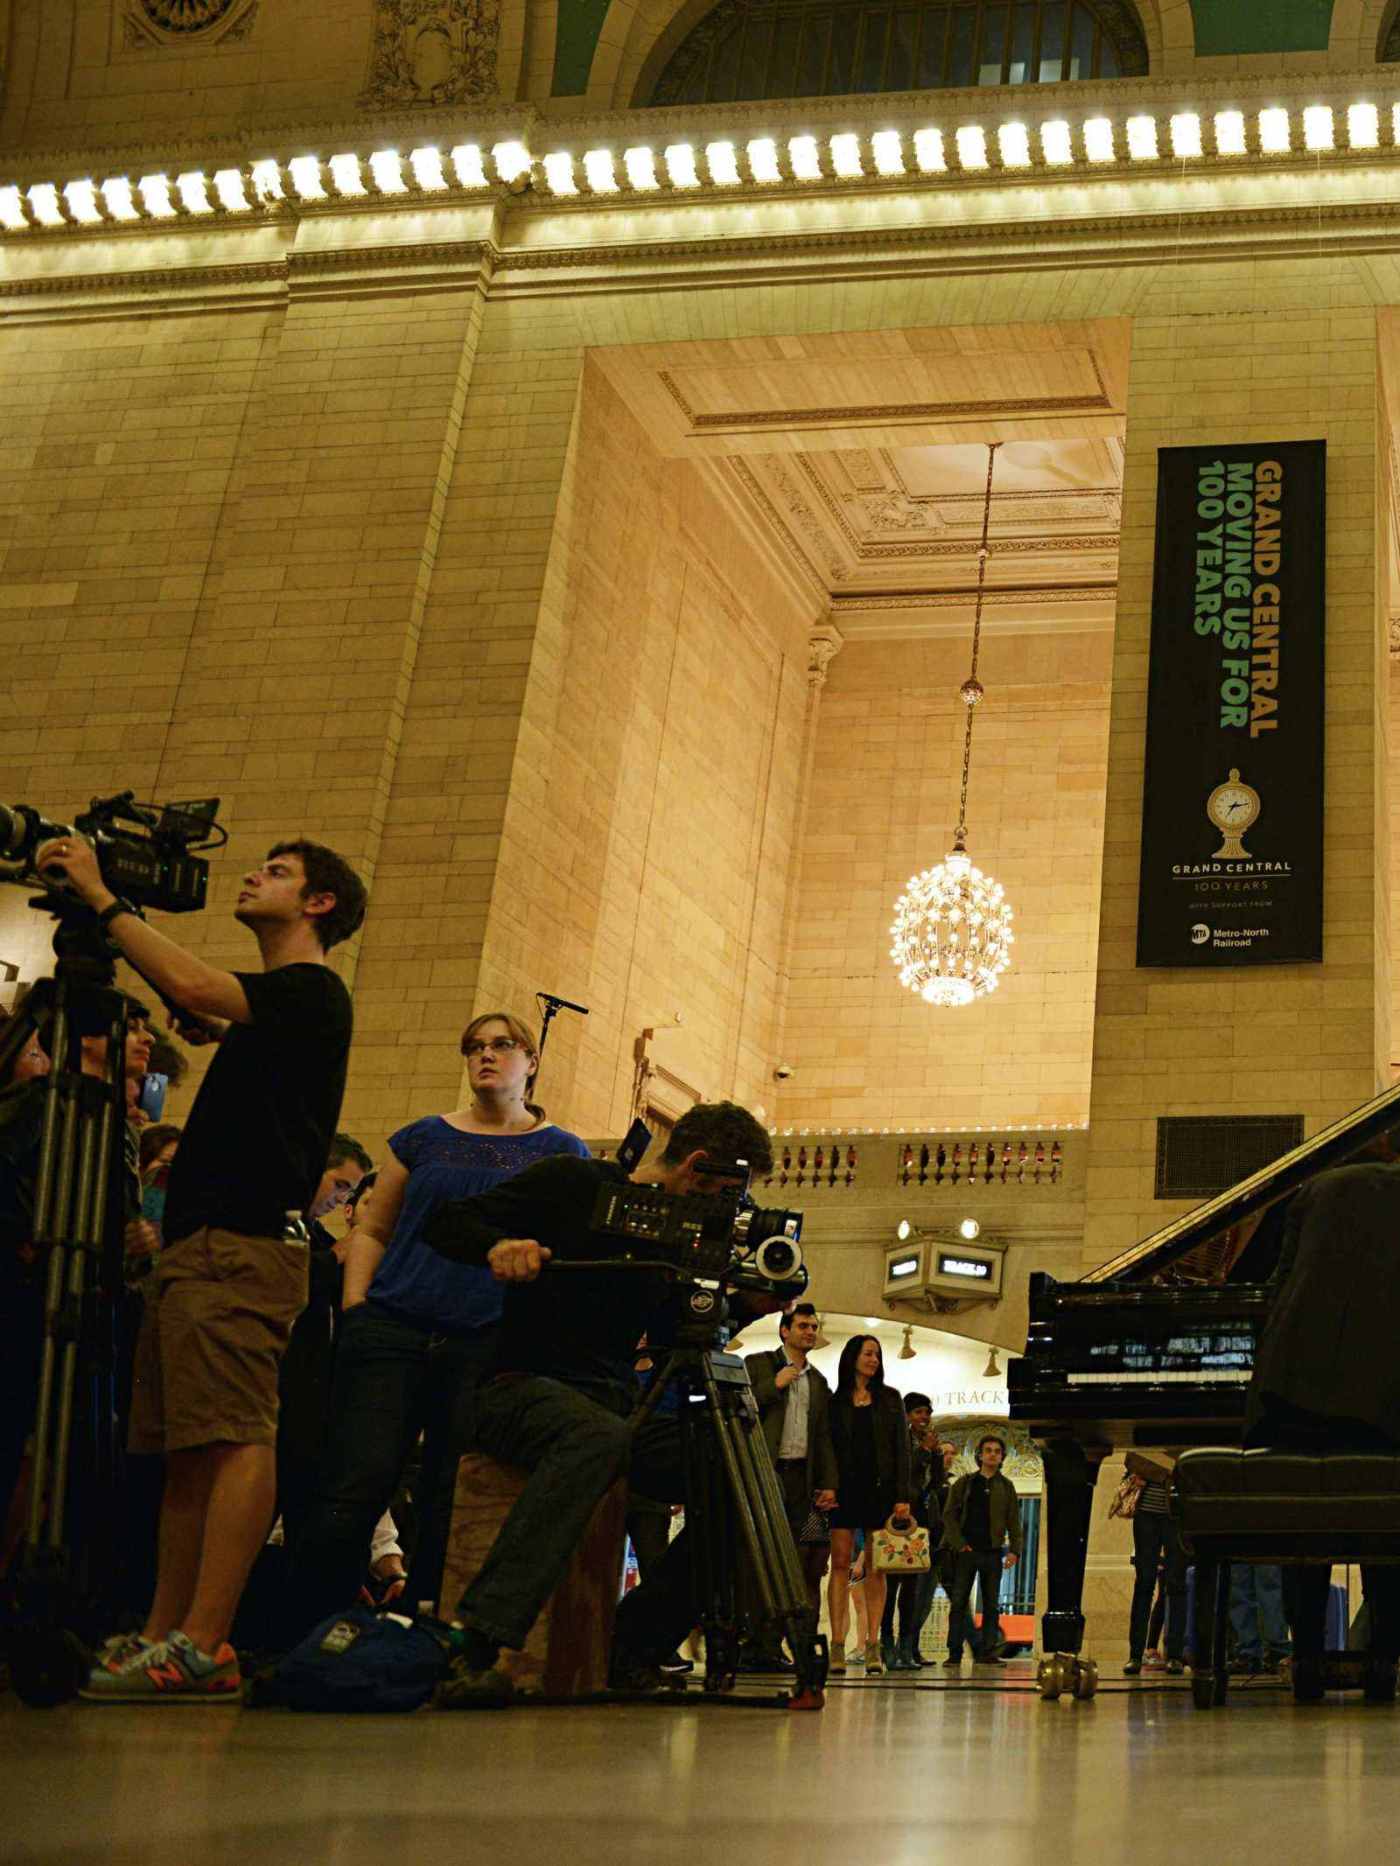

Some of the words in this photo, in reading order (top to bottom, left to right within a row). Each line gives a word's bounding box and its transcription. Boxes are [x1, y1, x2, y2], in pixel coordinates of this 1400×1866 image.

[1197, 459, 1225, 519] 100
[1253, 460, 1283, 576] GRAND
[1223, 462, 1254, 599] MOVING
[1193, 523, 1224, 636] YEARS
[1222, 607, 1251, 650] US
[1250, 583, 1281, 738] CENTRAL
[1220, 659, 1250, 728] FOR
[1172, 863, 1222, 874] GRAND
[1226, 861, 1292, 873] CENTRAL
[1194, 881, 1221, 892] 100
[1224, 880, 1268, 891] YEARS
[1213, 927, 1270, 938] Metro-North
[1213, 938, 1252, 948] Railroad
